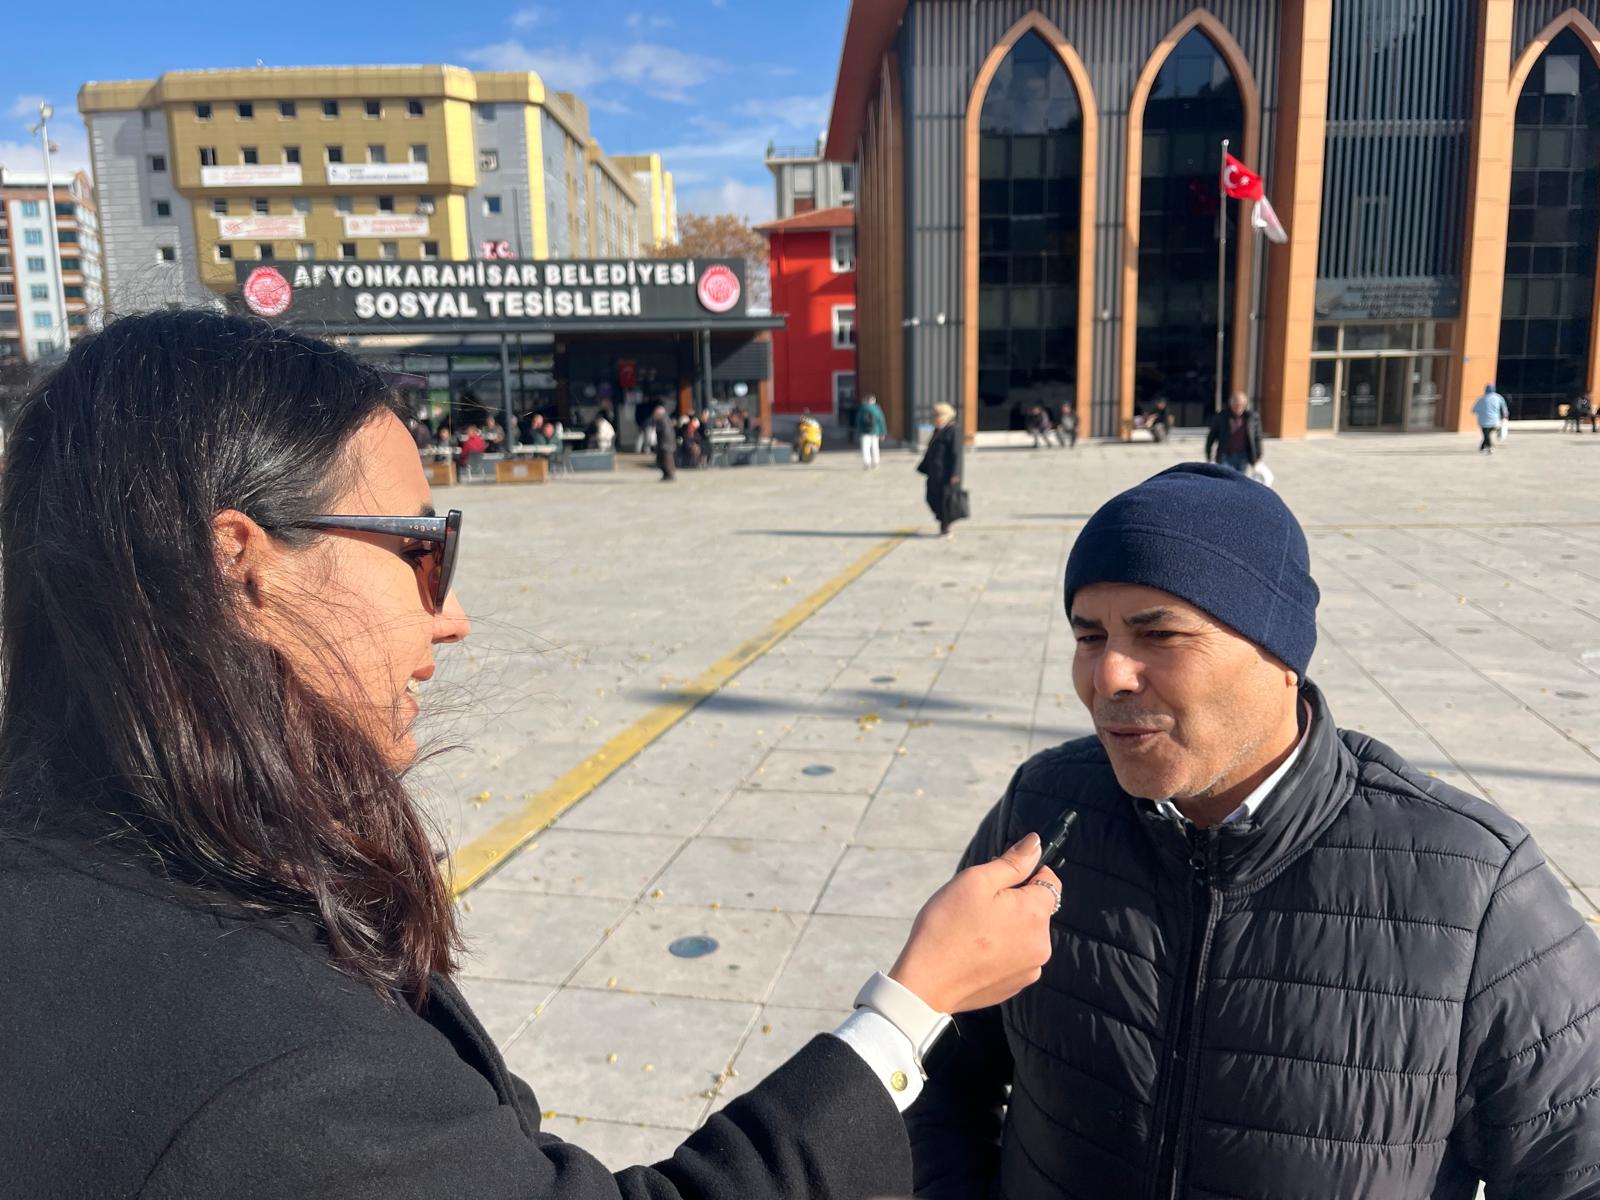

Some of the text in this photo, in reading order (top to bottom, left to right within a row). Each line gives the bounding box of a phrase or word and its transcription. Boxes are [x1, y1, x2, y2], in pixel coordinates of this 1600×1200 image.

[481, 240, 513, 260] T.C.
[293, 259, 696, 288] AFYONKARAHİSAR BELEDİYESİ
[355, 286, 642, 319] SOSYAL TESİSLERİ
